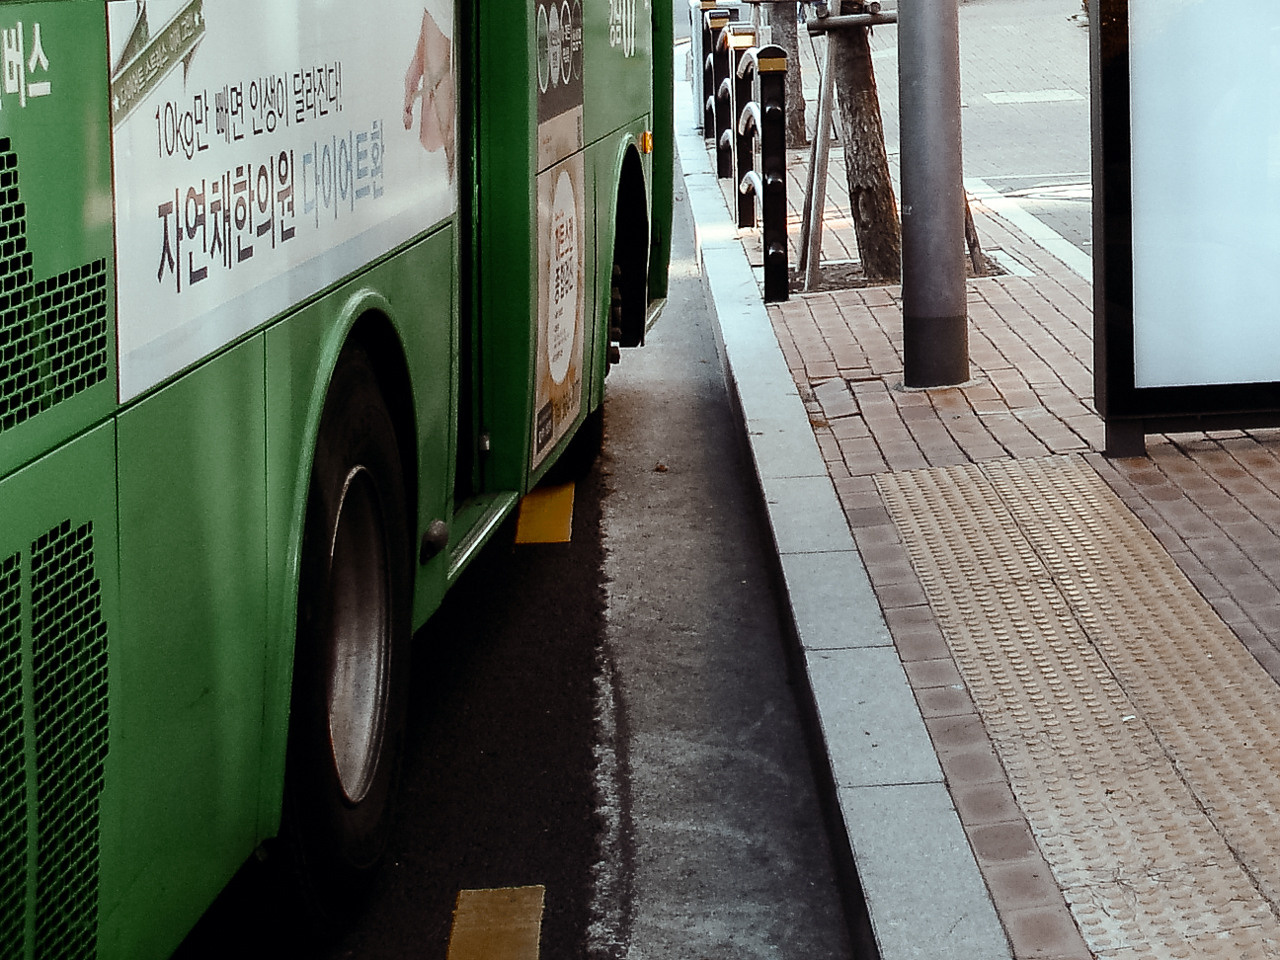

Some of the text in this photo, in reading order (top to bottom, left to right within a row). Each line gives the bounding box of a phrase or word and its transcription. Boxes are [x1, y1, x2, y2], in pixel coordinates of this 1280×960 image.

[0, 21, 52, 108] 버스
[156, 61, 342, 160] 10kg만 빼면 인생이 달라진다!
[158, 119, 385, 294] 자연채한의원 다이어트환
